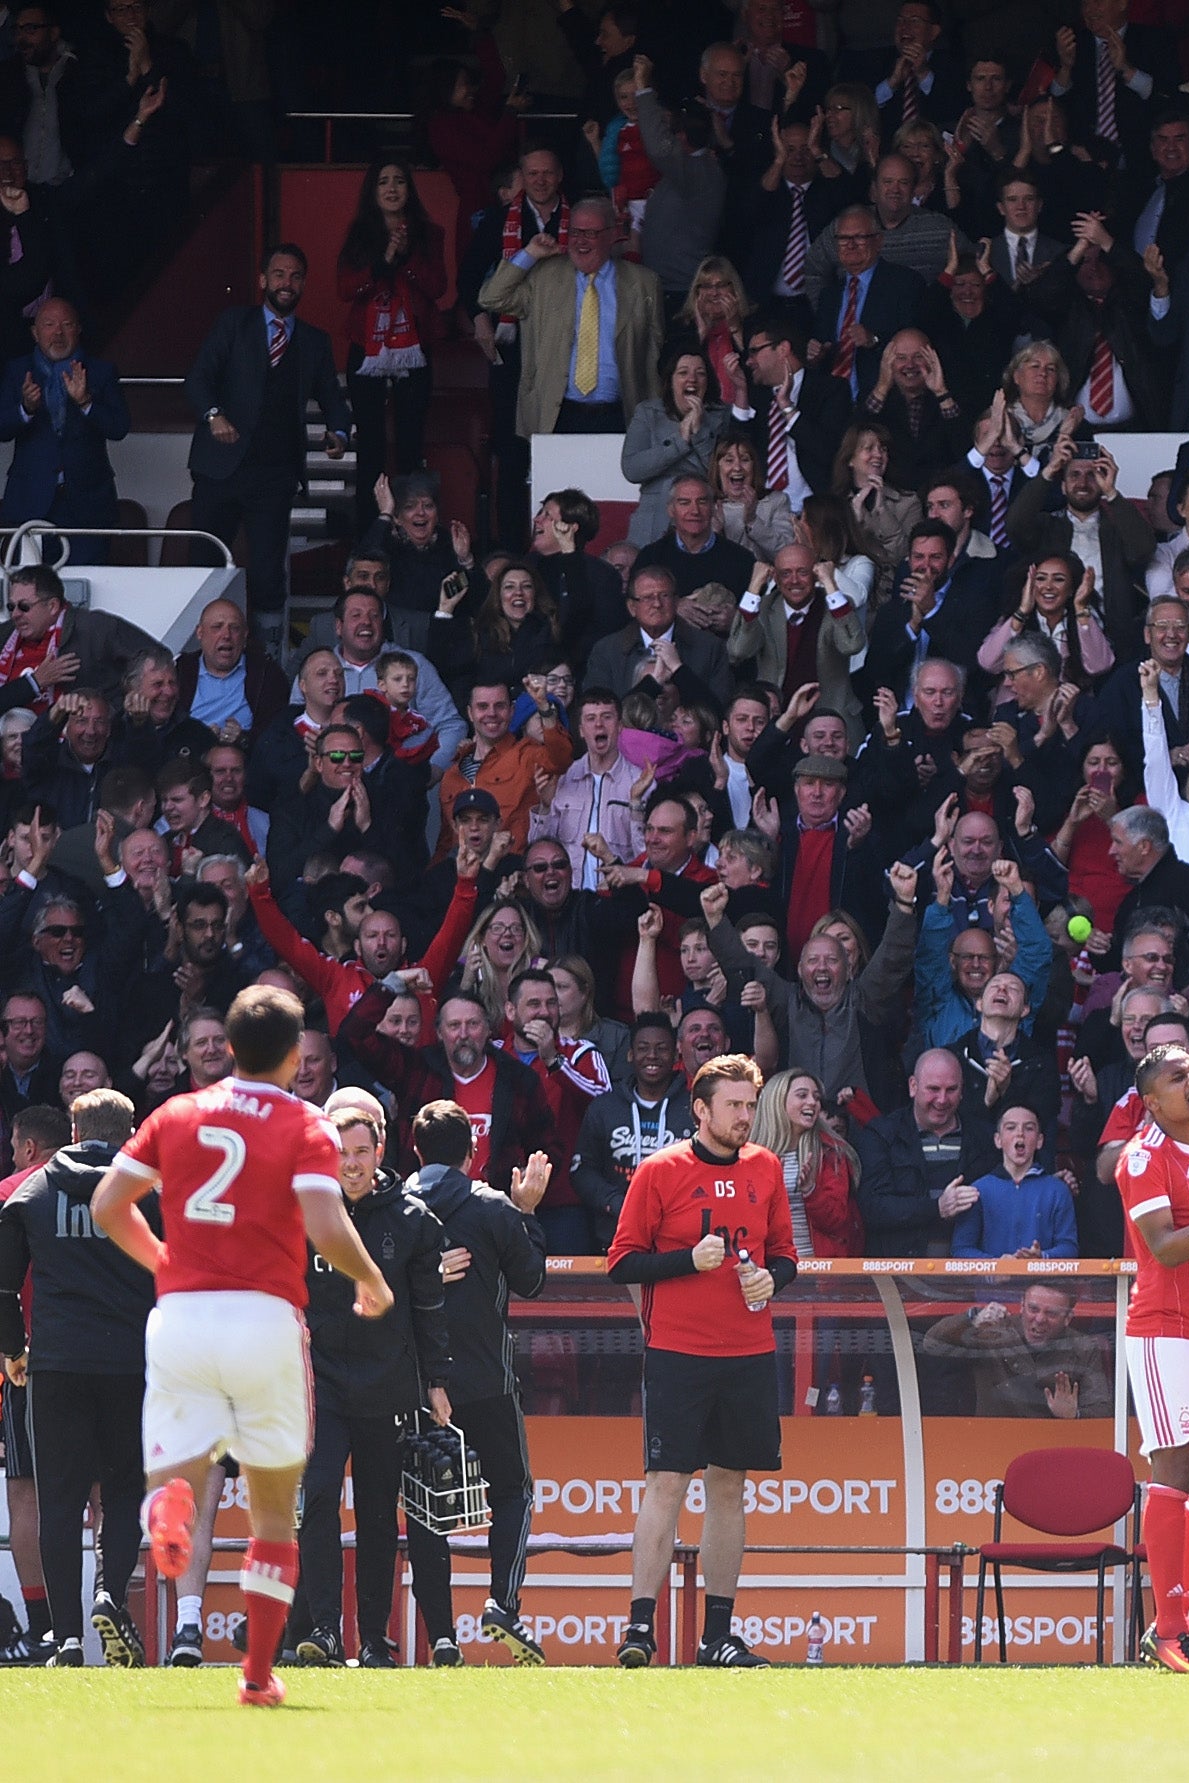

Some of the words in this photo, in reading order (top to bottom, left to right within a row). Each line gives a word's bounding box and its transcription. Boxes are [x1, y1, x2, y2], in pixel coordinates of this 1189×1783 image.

[184, 1126, 246, 1224] 2
[714, 1180, 736, 1197] DS
[797, 1261, 833, 1271] SPORT
[862, 1261, 915, 1272] 888SPORT
[945, 1261, 998, 1272] 888SPORT
[1027, 1262, 1080, 1273] 888SPORT
[533, 1478, 647, 1514] PORT
